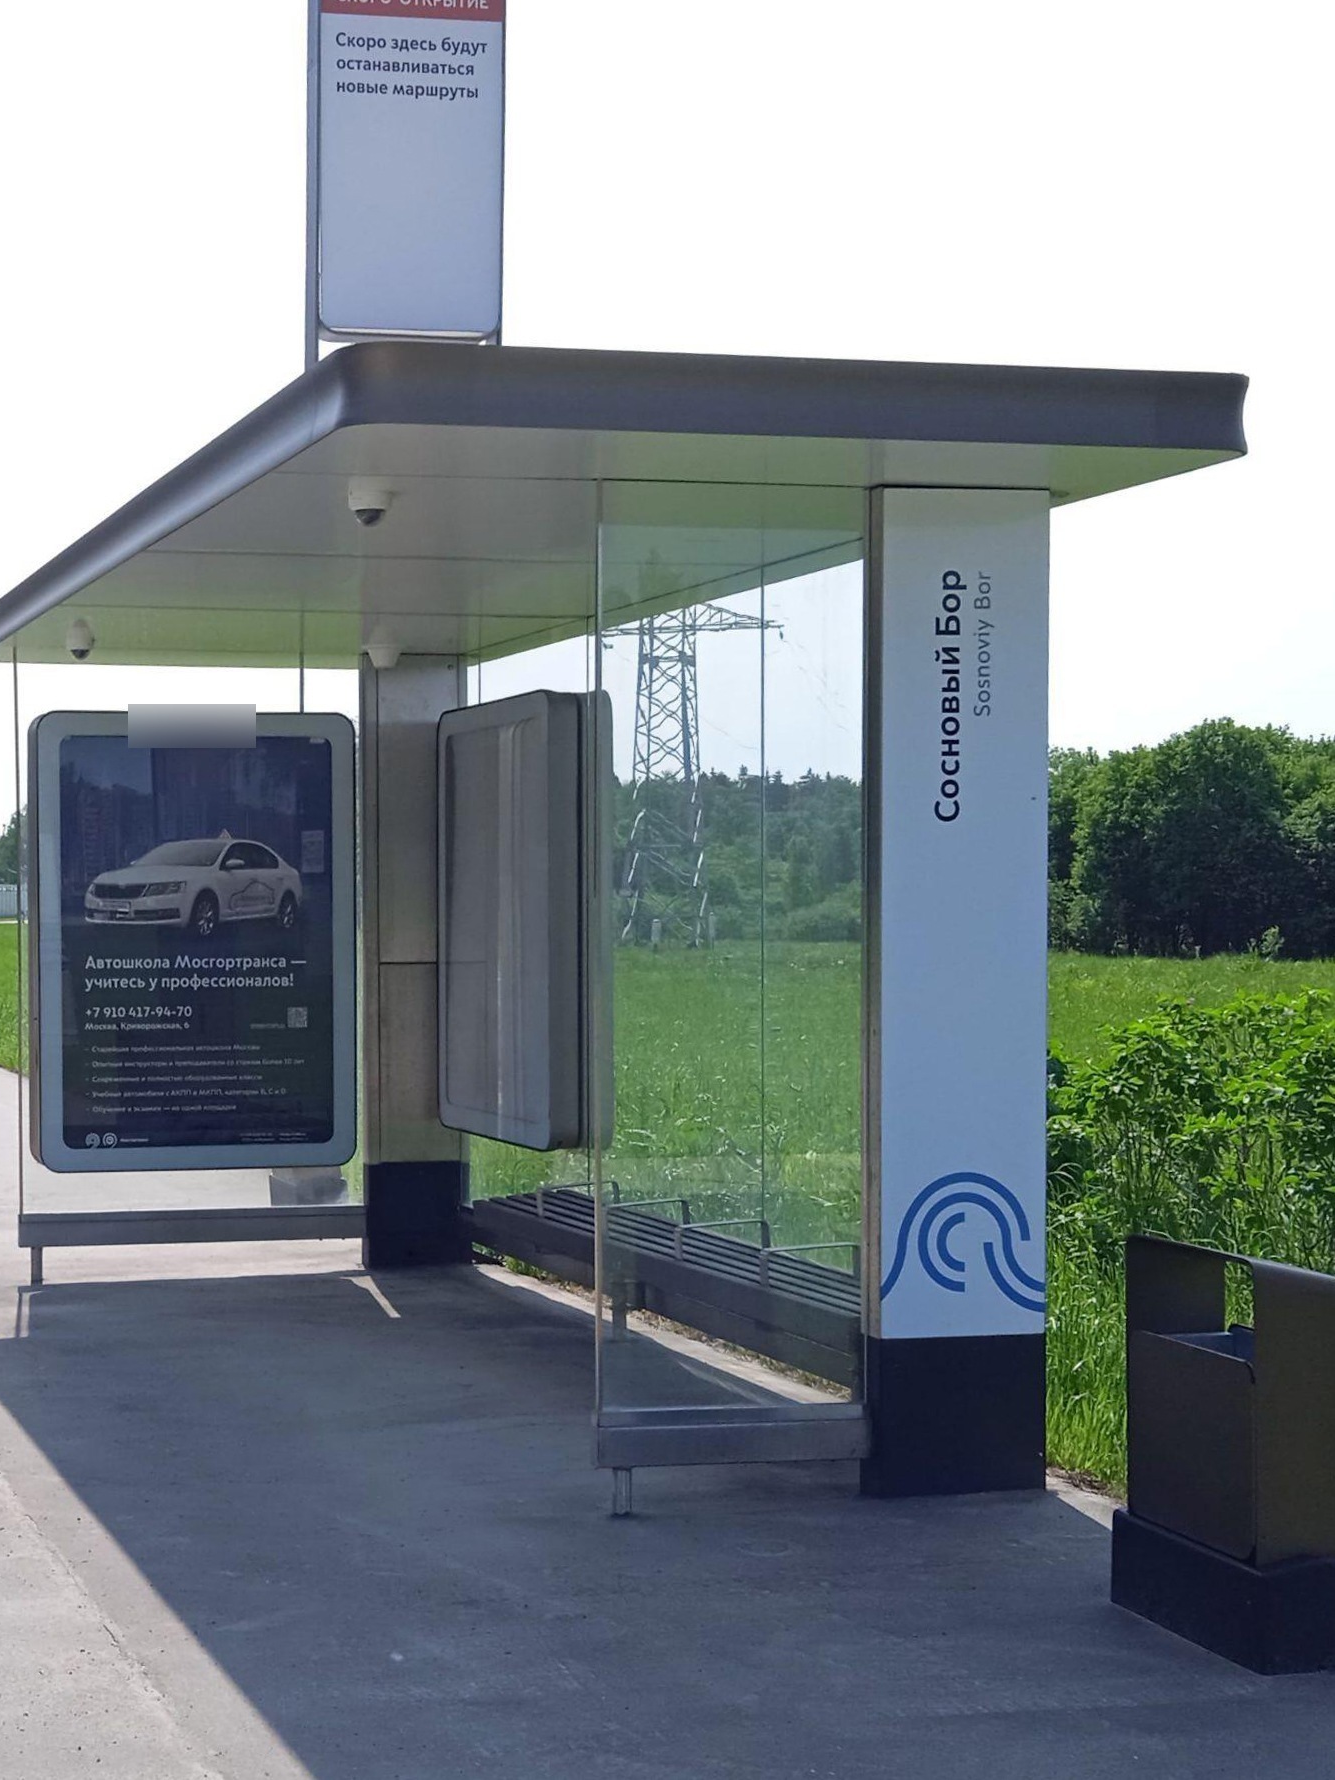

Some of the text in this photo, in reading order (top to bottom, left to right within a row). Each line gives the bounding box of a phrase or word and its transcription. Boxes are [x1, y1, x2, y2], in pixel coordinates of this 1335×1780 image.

[335, 32, 488, 56] Скоро здесь будут
[336, 58, 474, 76] останавливаться
[336, 81, 479, 101] новые маршруты
[974, 572, 995, 716] Sosnoviy Bor
[934, 570, 967, 822] Сосновый Бор
[85, 955, 170, 970] Автошкола
[174, 955, 286, 971] Мосгортранса
[85, 973, 294, 992] учитесь у профессионалов!
[85, 1006, 192, 1018] +7 910 417-94-70
